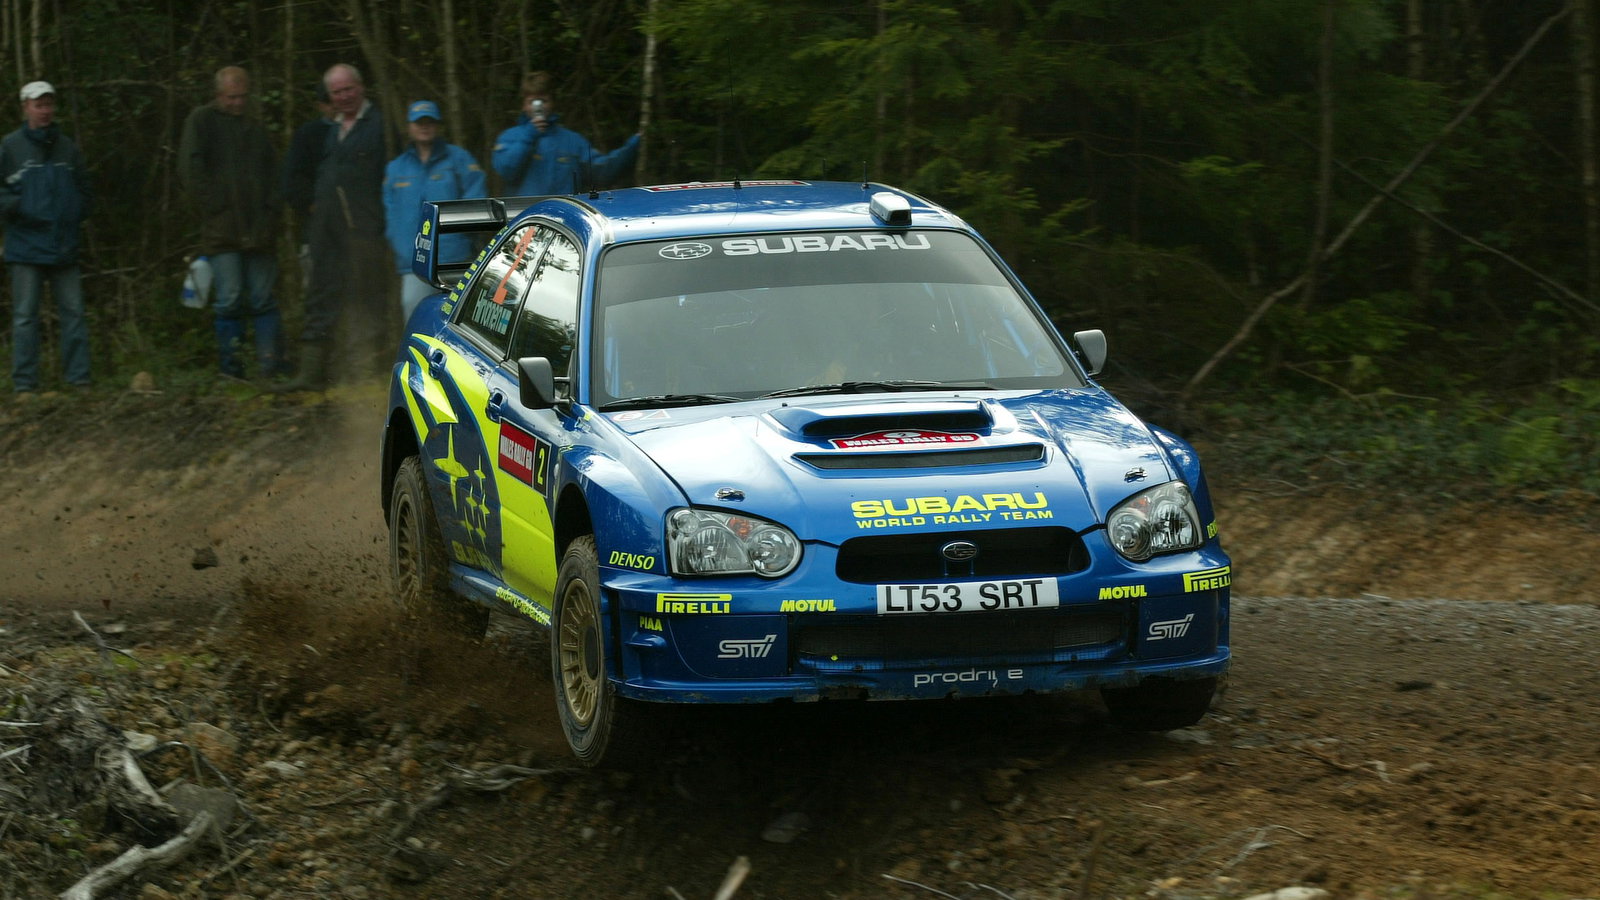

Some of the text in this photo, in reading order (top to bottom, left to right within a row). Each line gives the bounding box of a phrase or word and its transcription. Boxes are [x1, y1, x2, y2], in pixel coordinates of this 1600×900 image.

[721, 234, 931, 256] SUBARU
[844, 438, 900, 447] WALES
[902, 436, 946, 444] RALLY
[537, 447, 545, 485] 2
[851, 492, 1048, 518] SUBARU
[856, 510, 1053, 529] WORLD RALLY TEAM
[609, 551, 655, 570] DENSO
[885, 580, 1043, 612] LT53 SRT
[1098, 585, 1148, 600] MOTUL
[656, 593, 733, 614] PIRELLI
[780, 599, 836, 613] MOTUL
[639, 616, 663, 632] PIAA
